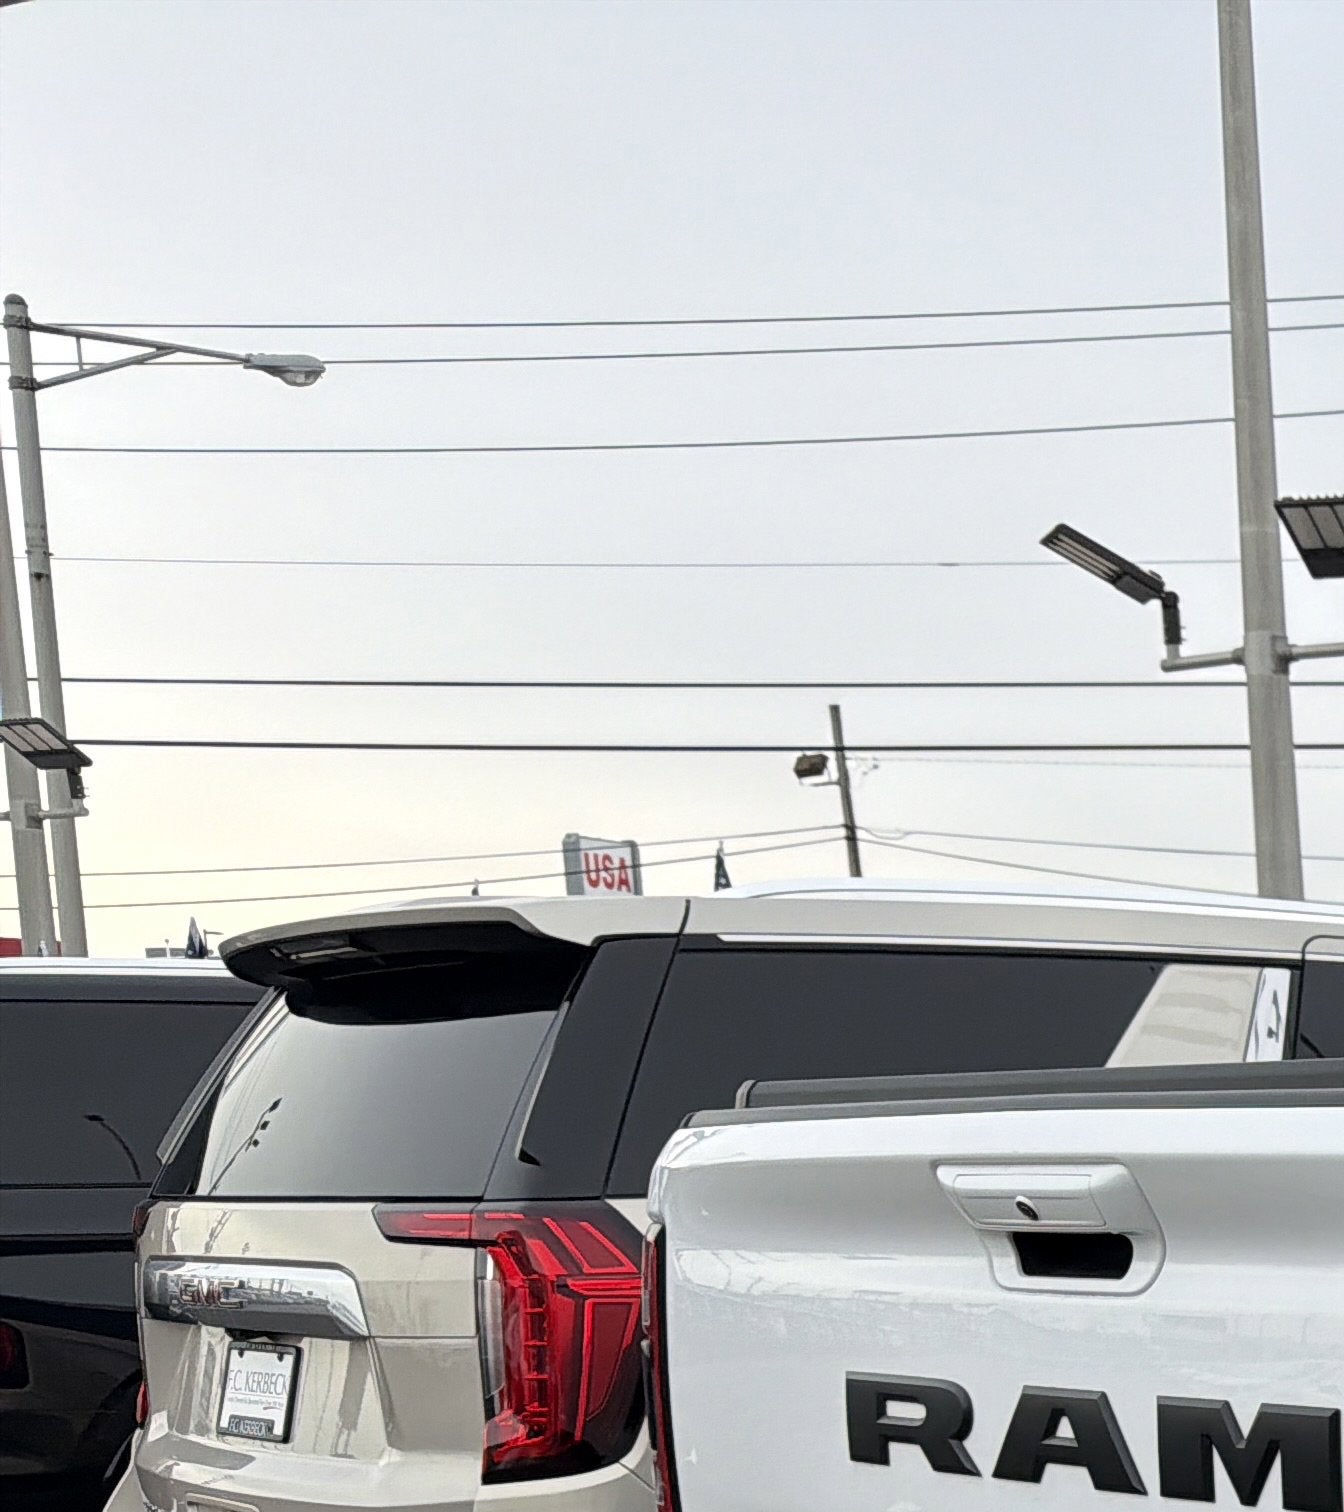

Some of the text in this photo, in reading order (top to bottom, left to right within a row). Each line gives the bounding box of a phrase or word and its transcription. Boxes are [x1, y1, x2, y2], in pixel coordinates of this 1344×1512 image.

[583, 852, 631, 893] USA
[179, 1278, 245, 1309] GMC
[244, 1370, 288, 1396] KERBECK
